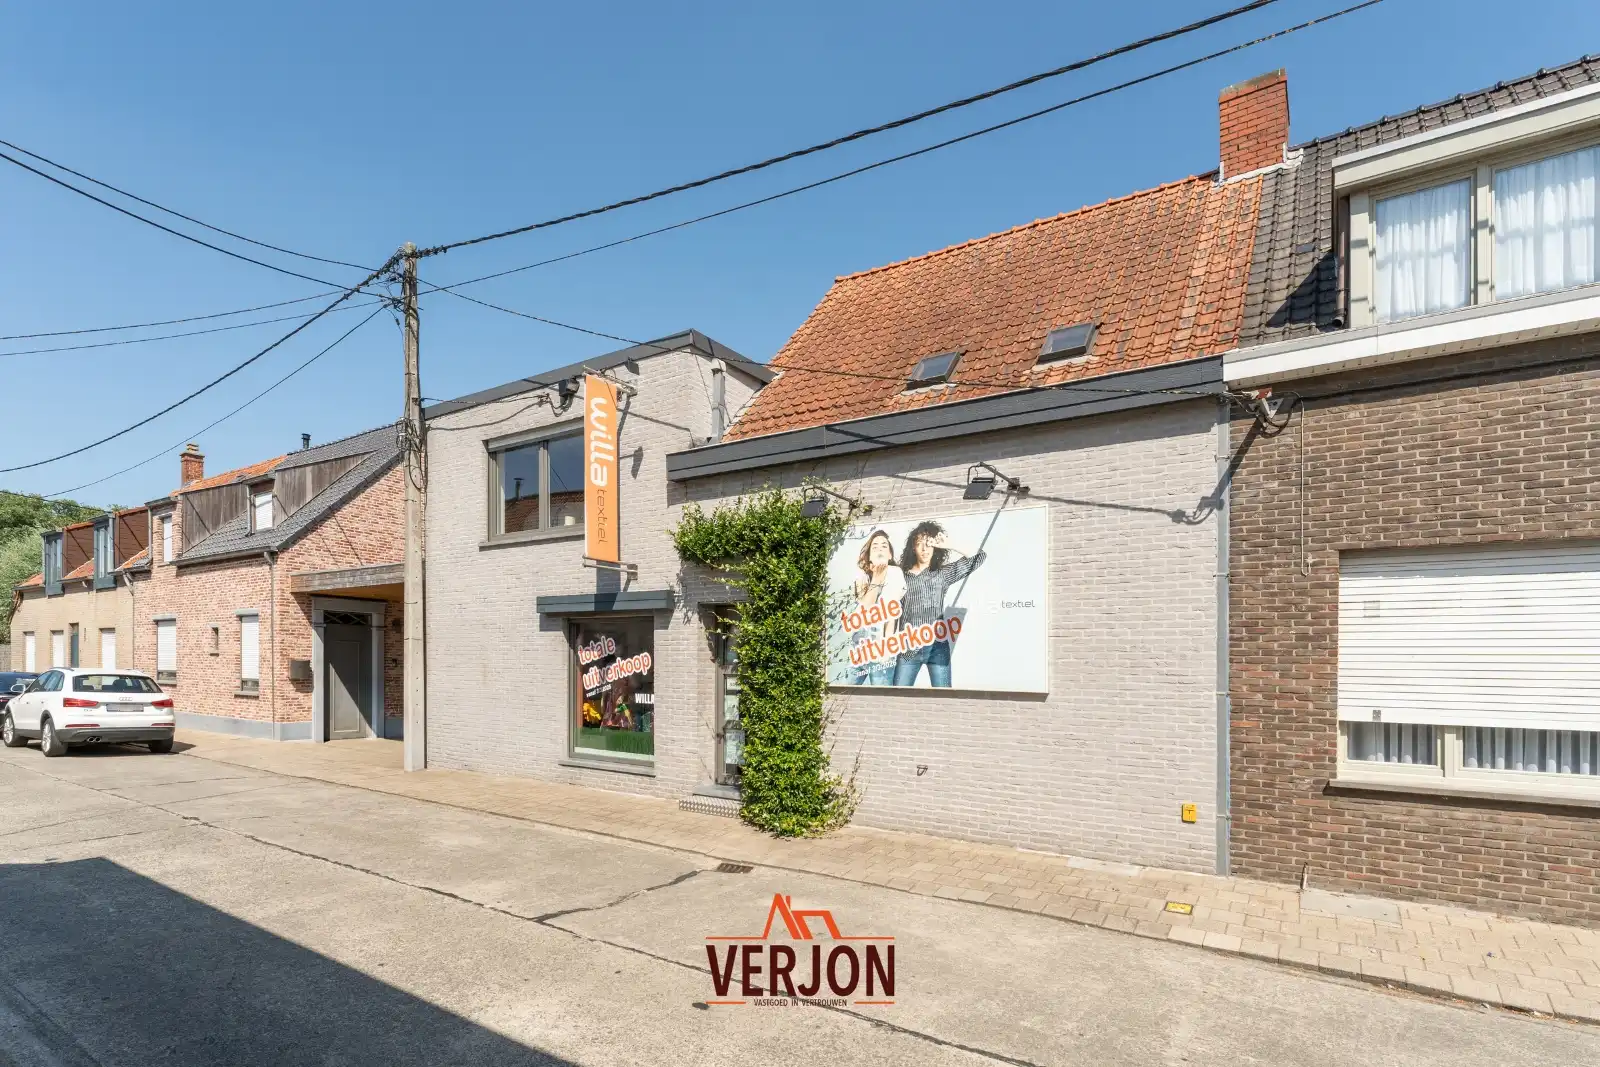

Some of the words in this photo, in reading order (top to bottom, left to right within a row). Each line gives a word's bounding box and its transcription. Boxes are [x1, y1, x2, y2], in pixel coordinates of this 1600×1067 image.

[590, 397, 614, 487] willa
[597, 489, 607, 544] textiel
[841, 597, 902, 633] totale
[1001, 599, 1035, 609] textiel
[578, 636, 616, 665] totale
[849, 616, 962, 665] uitverkoop
[582, 652, 651, 690] uitverkoop
